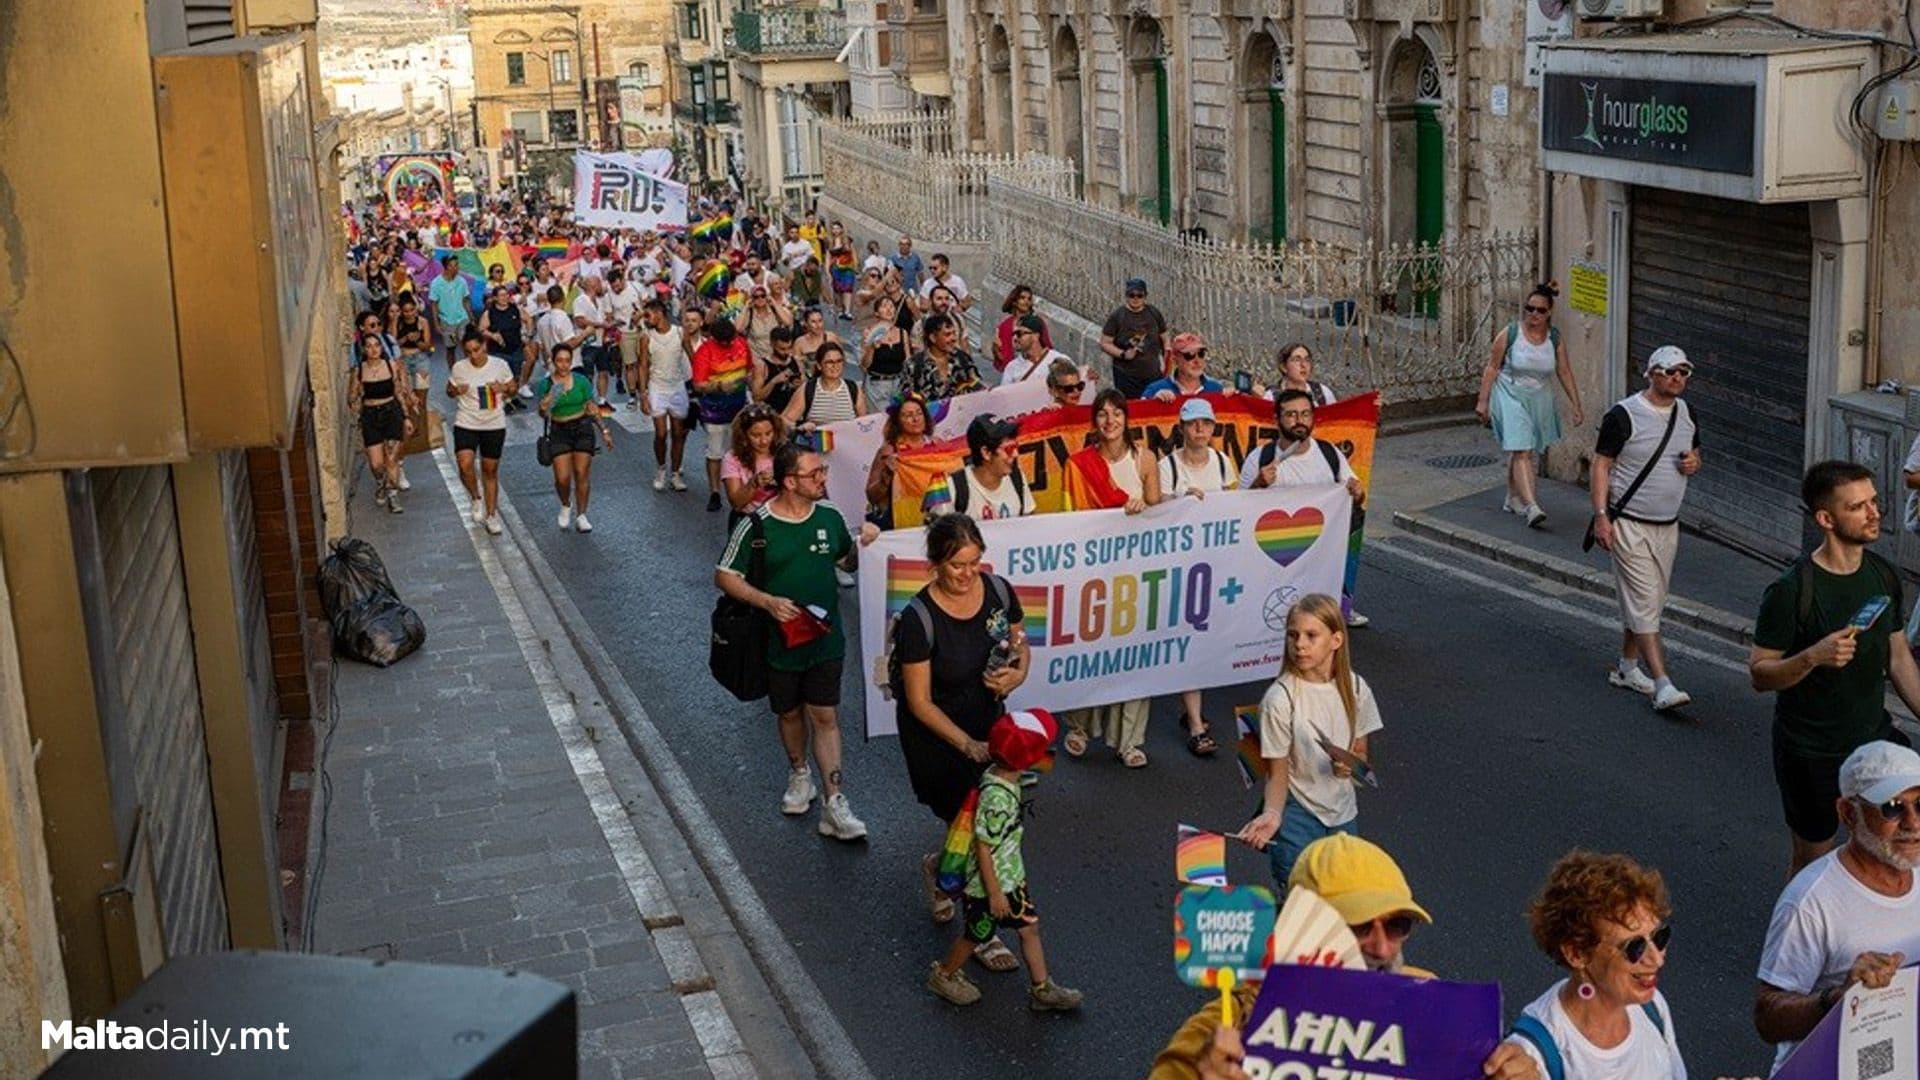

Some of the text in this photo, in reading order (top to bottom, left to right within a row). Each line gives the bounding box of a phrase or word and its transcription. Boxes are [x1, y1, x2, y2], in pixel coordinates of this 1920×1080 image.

[1602, 93, 1688, 137] hourglass
[590, 171, 666, 213] PRIDE
[1008, 519, 1242, 575] FSWS SUPPORTS THE
[1051, 562, 1244, 646] LGBTIQ+
[1048, 636, 1191, 684] COMMUNITY
[1196, 910, 1256, 932] CHOOSE
[1201, 932, 1250, 953] HAPPY
